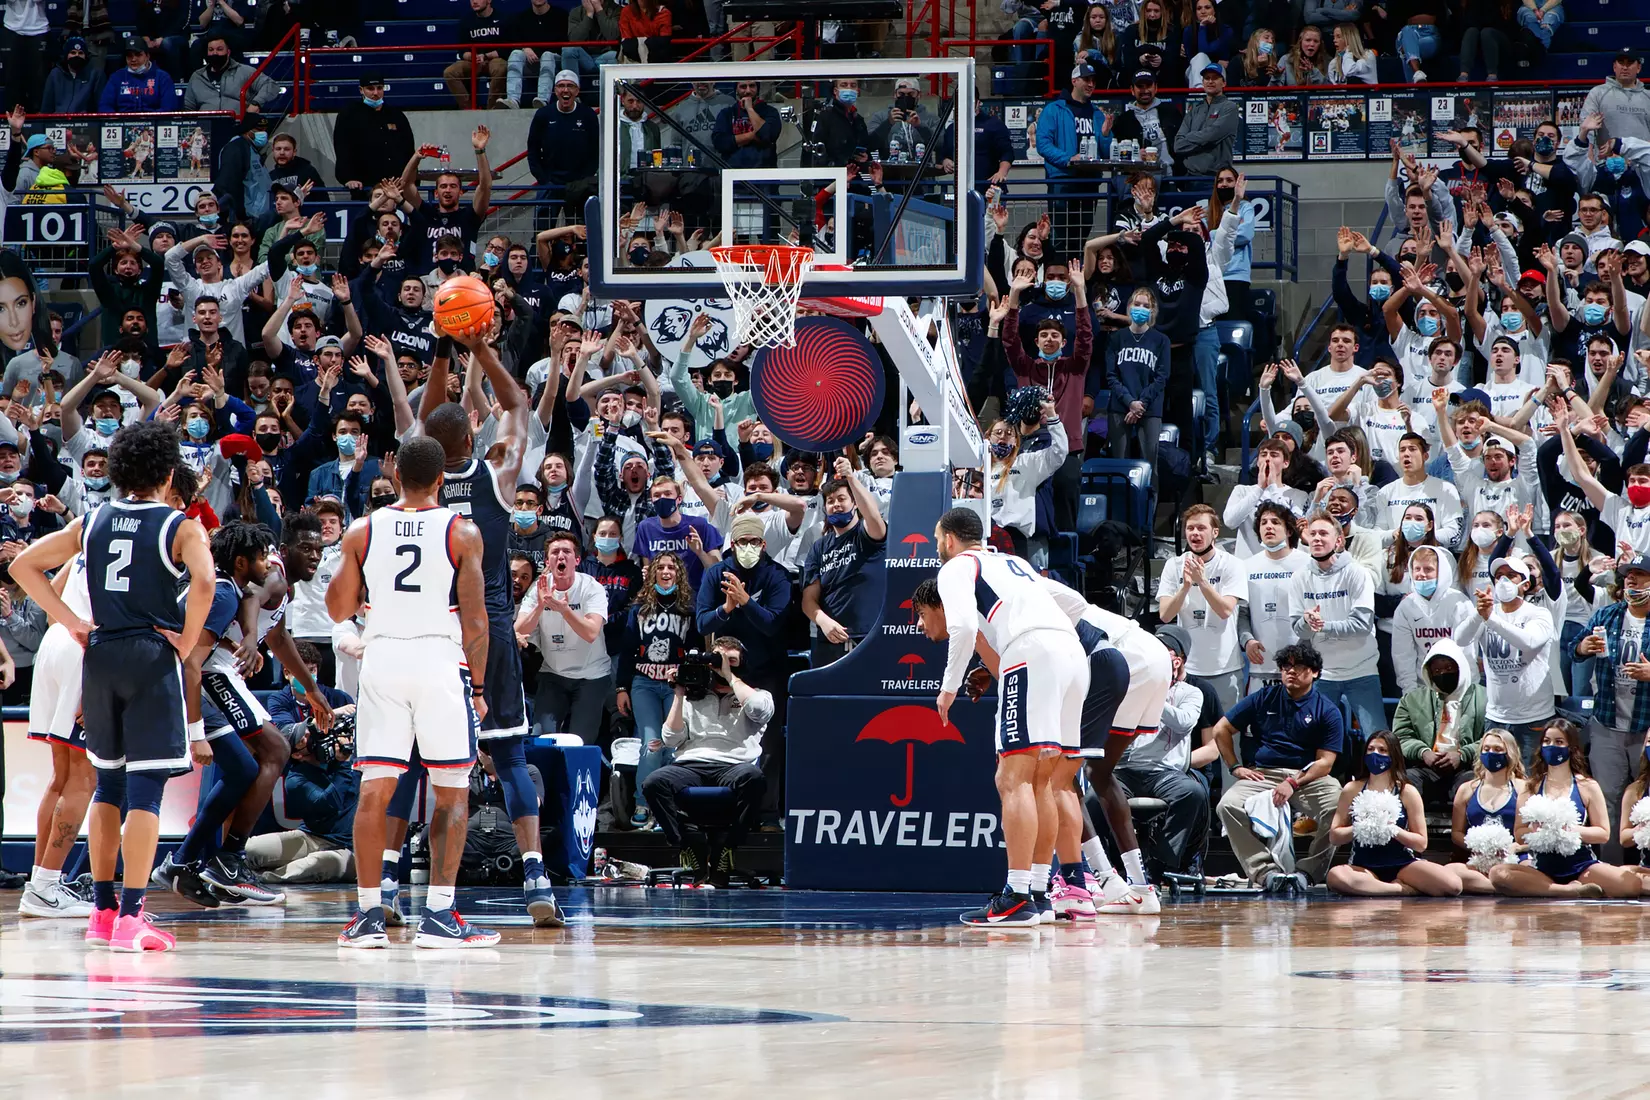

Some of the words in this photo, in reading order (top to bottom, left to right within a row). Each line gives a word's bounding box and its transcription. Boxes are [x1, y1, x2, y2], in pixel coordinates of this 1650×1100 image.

[470, 27, 500, 39] UCONN
[1250, 103, 1264, 113] 20
[1375, 100, 1385, 111] 31
[1437, 99, 1448, 110] 23
[1012, 108, 1020, 118] 32
[163, 127, 172, 138] 33
[1075, 116, 1096, 135] CON
[106, 128, 118, 139] 25
[126, 192, 153, 207] EC
[161, 186, 203, 211] 20
[21, 212, 82, 241] 101
[391, 330, 430, 351] UCONN
[1117, 346, 1158, 373] UCONN
[112, 517, 141, 533] HARRIS
[395, 520, 425, 537] COLE
[105, 539, 133, 592] 2
[394, 544, 421, 593] 2
[884, 558, 942, 568] TRAVELERS
[1006, 559, 1035, 582] 4
[1250, 573, 1263, 581] BEAT
[1264, 571, 1293, 580] GEORGETO
[1315, 589, 1349, 600] GEORGETOWN
[882, 624, 924, 635] TRAVEL
[1415, 627, 1452, 639] UCONN
[881, 680, 941, 690] TRAVELERS
[207, 674, 250, 731] HUSKIES
[1005, 674, 1019, 744] HUSKIES
[788, 809, 1006, 849] TRAVELER
